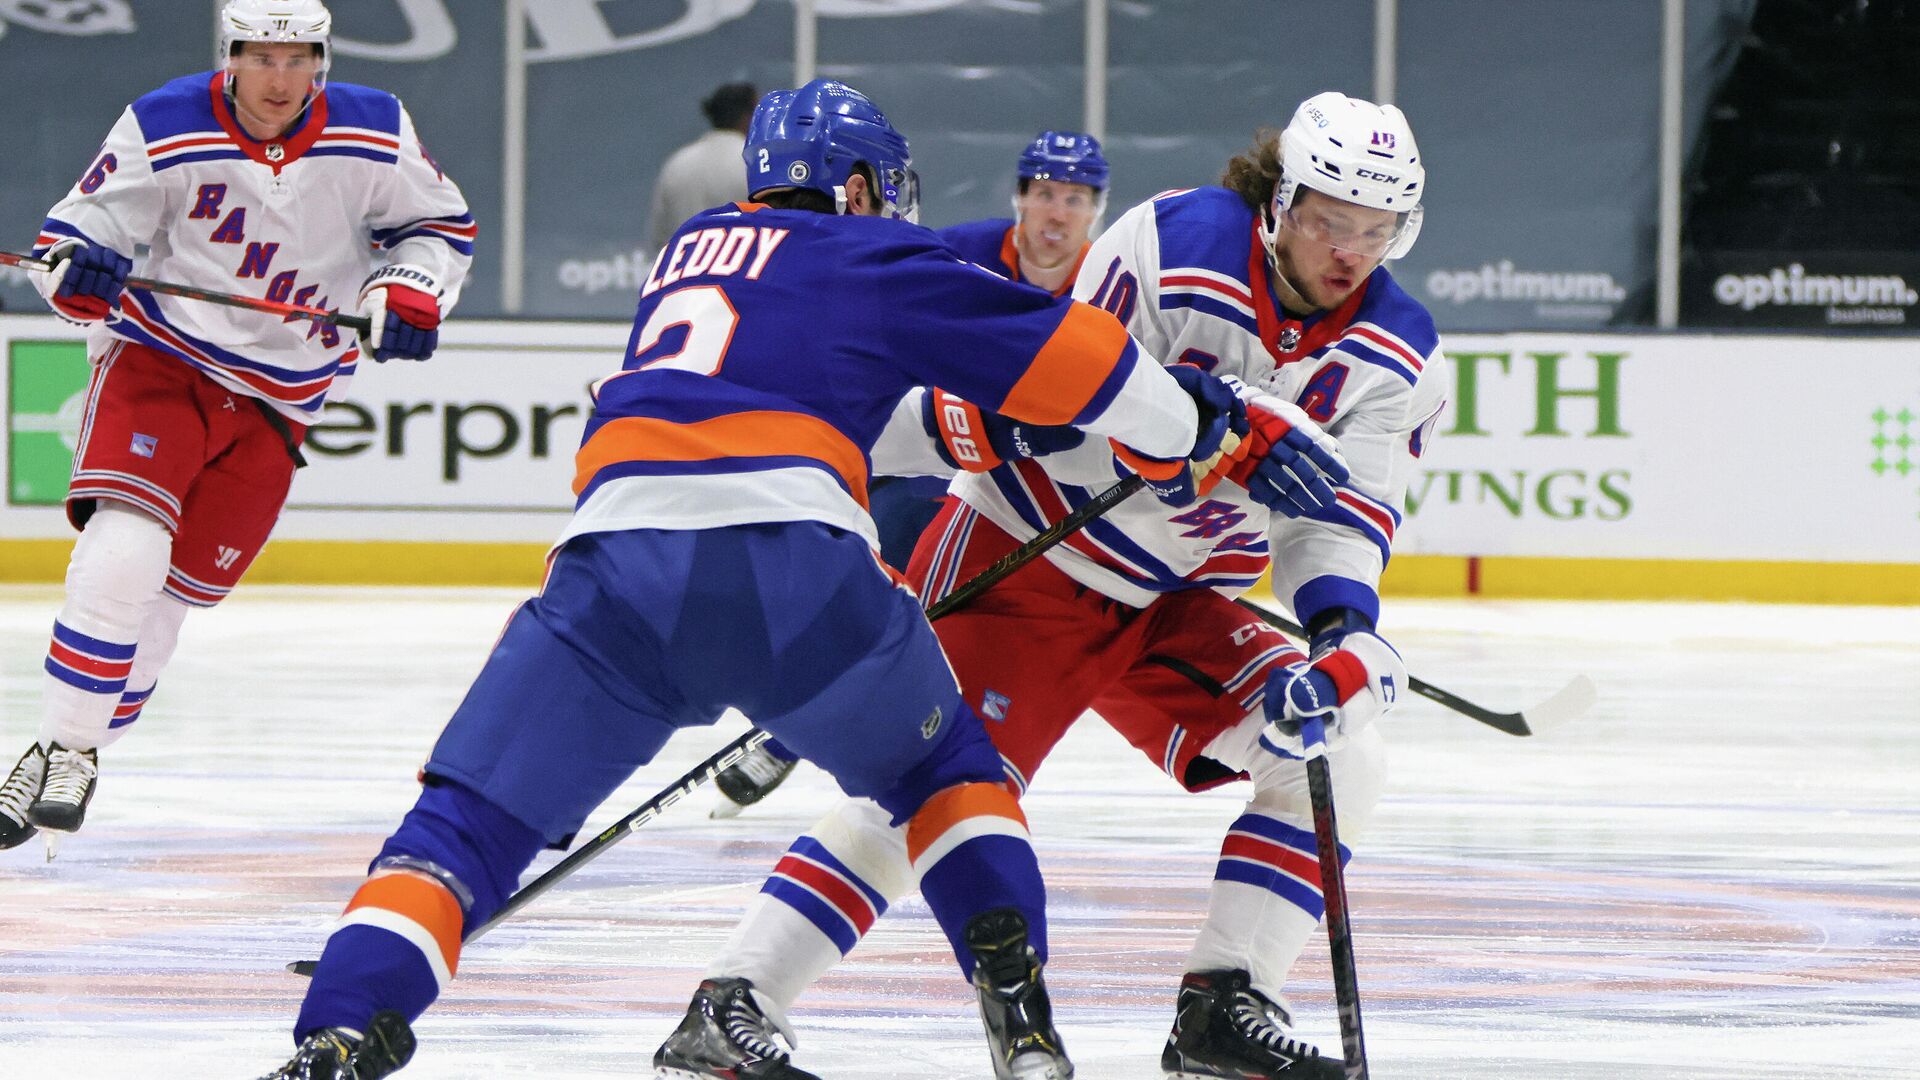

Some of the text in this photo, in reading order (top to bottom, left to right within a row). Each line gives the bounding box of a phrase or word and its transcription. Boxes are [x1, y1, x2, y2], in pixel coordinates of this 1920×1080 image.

[77, 142, 118, 195] 6
[758, 148, 771, 174] 2
[1355, 168, 1400, 184] CCM
[640, 226, 791, 299] LEDDY
[1088, 255, 1139, 329] 10
[635, 284, 741, 377] 2
[1295, 360, 1350, 424] A
